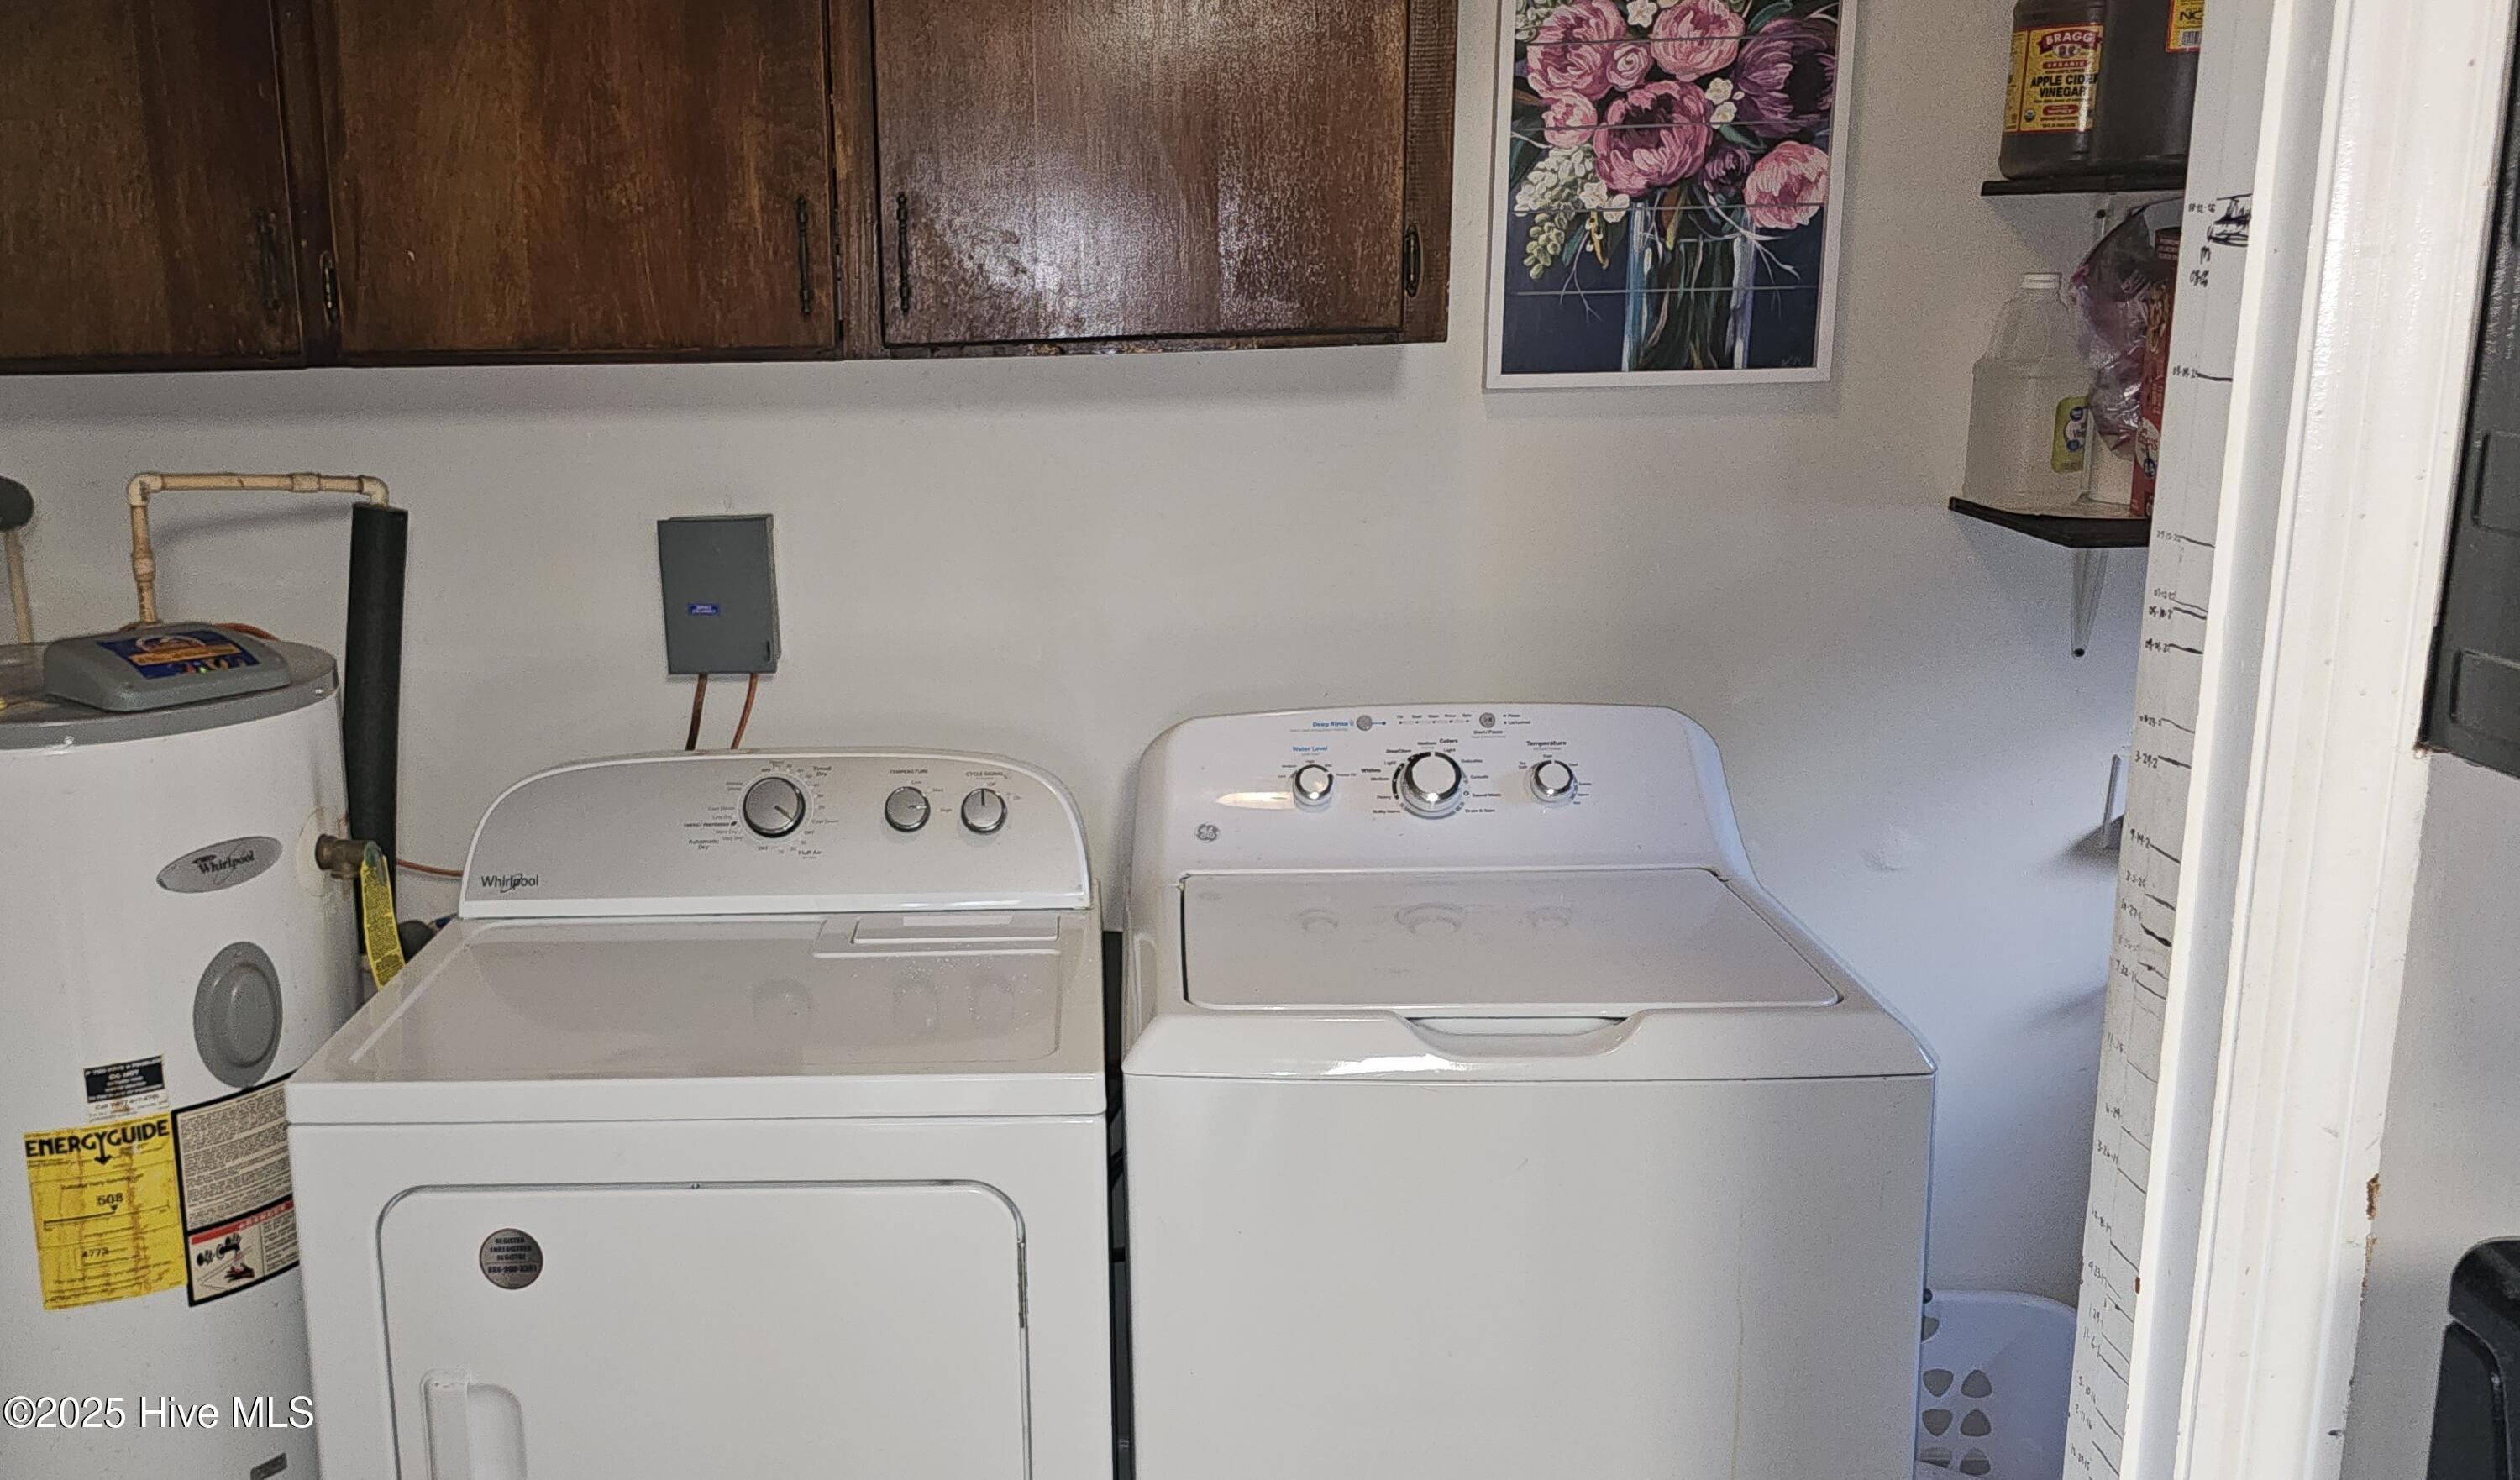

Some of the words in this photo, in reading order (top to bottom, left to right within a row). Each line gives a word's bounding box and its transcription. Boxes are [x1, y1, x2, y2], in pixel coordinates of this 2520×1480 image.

[2045, 32, 2096, 45] BRAGG
[2030, 74, 2063, 88] APPLE
[2040, 87, 2087, 98] VINEGAR
[197, 850, 255, 875] Whirlpool
[480, 873, 539, 893] Whirlpool
[24, 1119, 171, 1164] ENERGYGUIDE
[97, 1192, 124, 1206] 508
